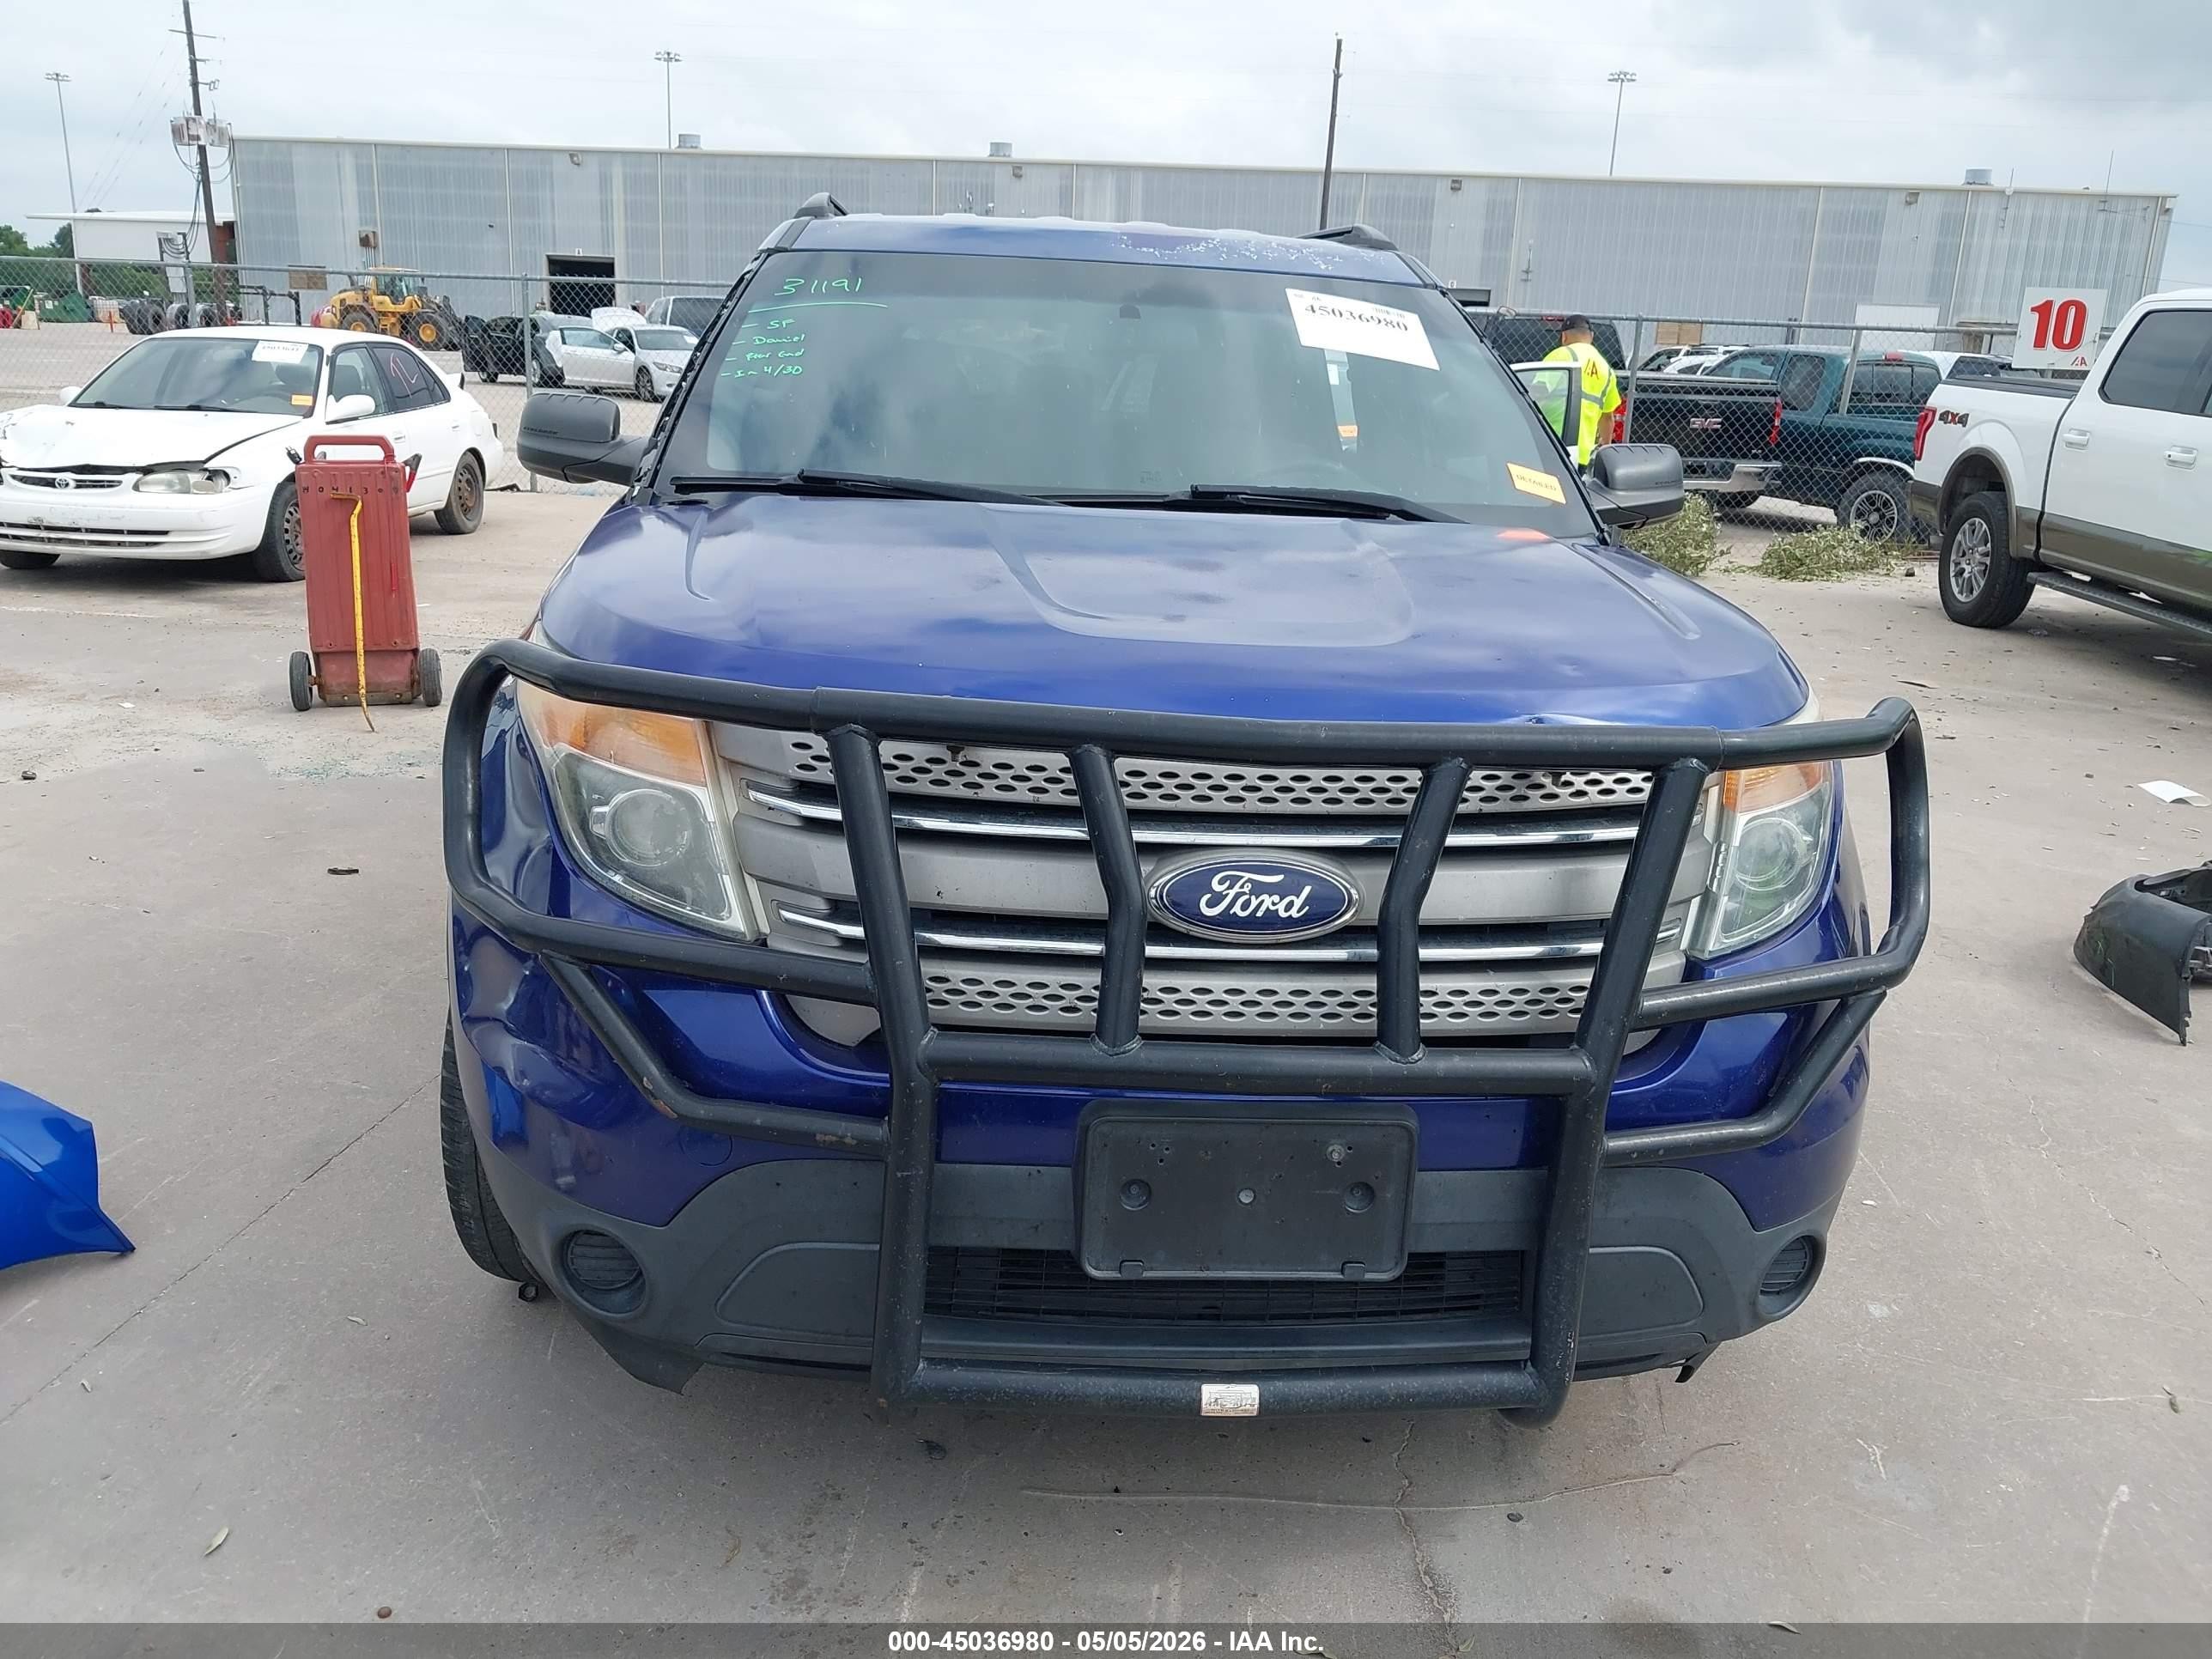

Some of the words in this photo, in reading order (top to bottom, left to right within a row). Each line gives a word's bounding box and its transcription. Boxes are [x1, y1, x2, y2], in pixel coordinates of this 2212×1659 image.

[775, 277, 862, 296] 31191
[1296, 303, 1409, 332] 45036980
[2029, 298, 2089, 352] 10
[764, 364, 803, 376] 4/30
[1199, 870, 1312, 918] Ford
